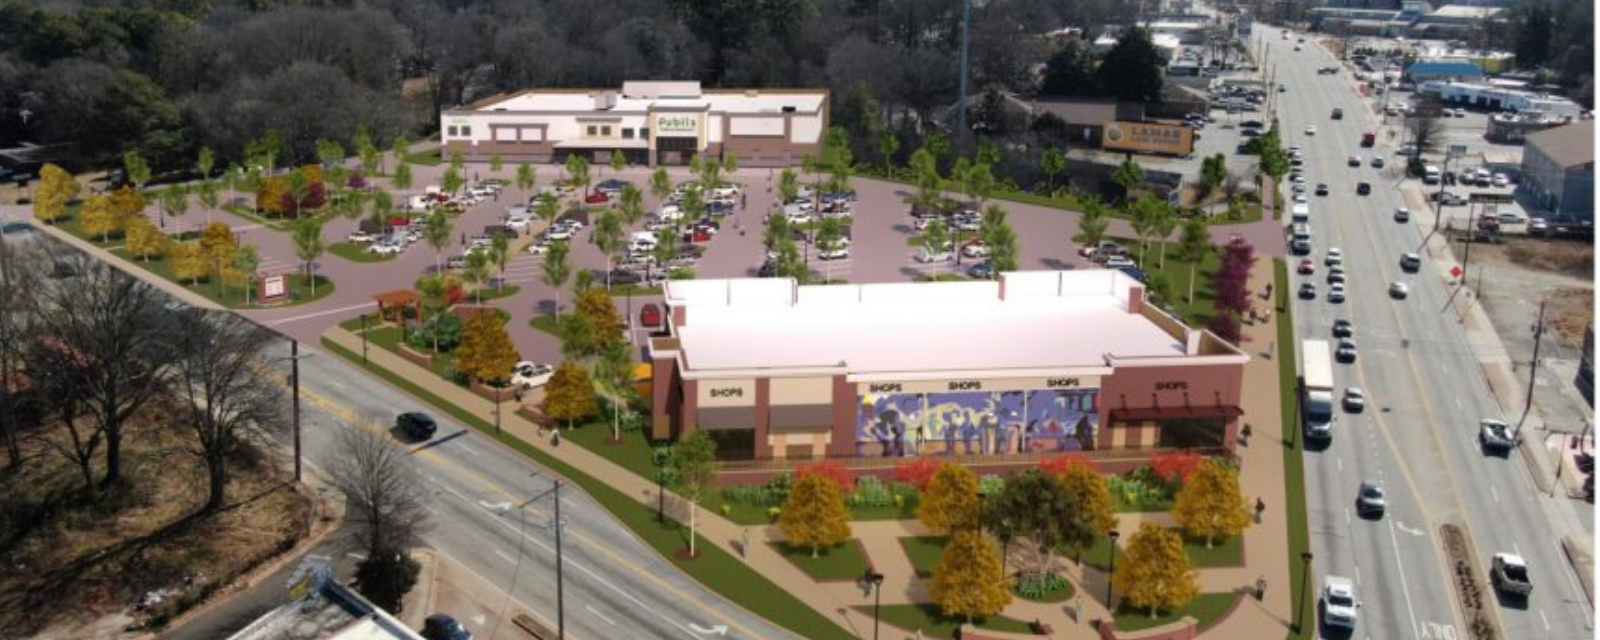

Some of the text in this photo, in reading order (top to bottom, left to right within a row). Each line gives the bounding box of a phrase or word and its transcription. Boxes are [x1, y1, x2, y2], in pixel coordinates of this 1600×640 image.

[948, 381, 982, 391] SHOPS
[1047, 377, 1080, 388] SHOPS
[1155, 381, 1188, 391] SHOPS
[710, 387, 743, 398] SHOPS
[869, 383, 902, 393] SHOPS
